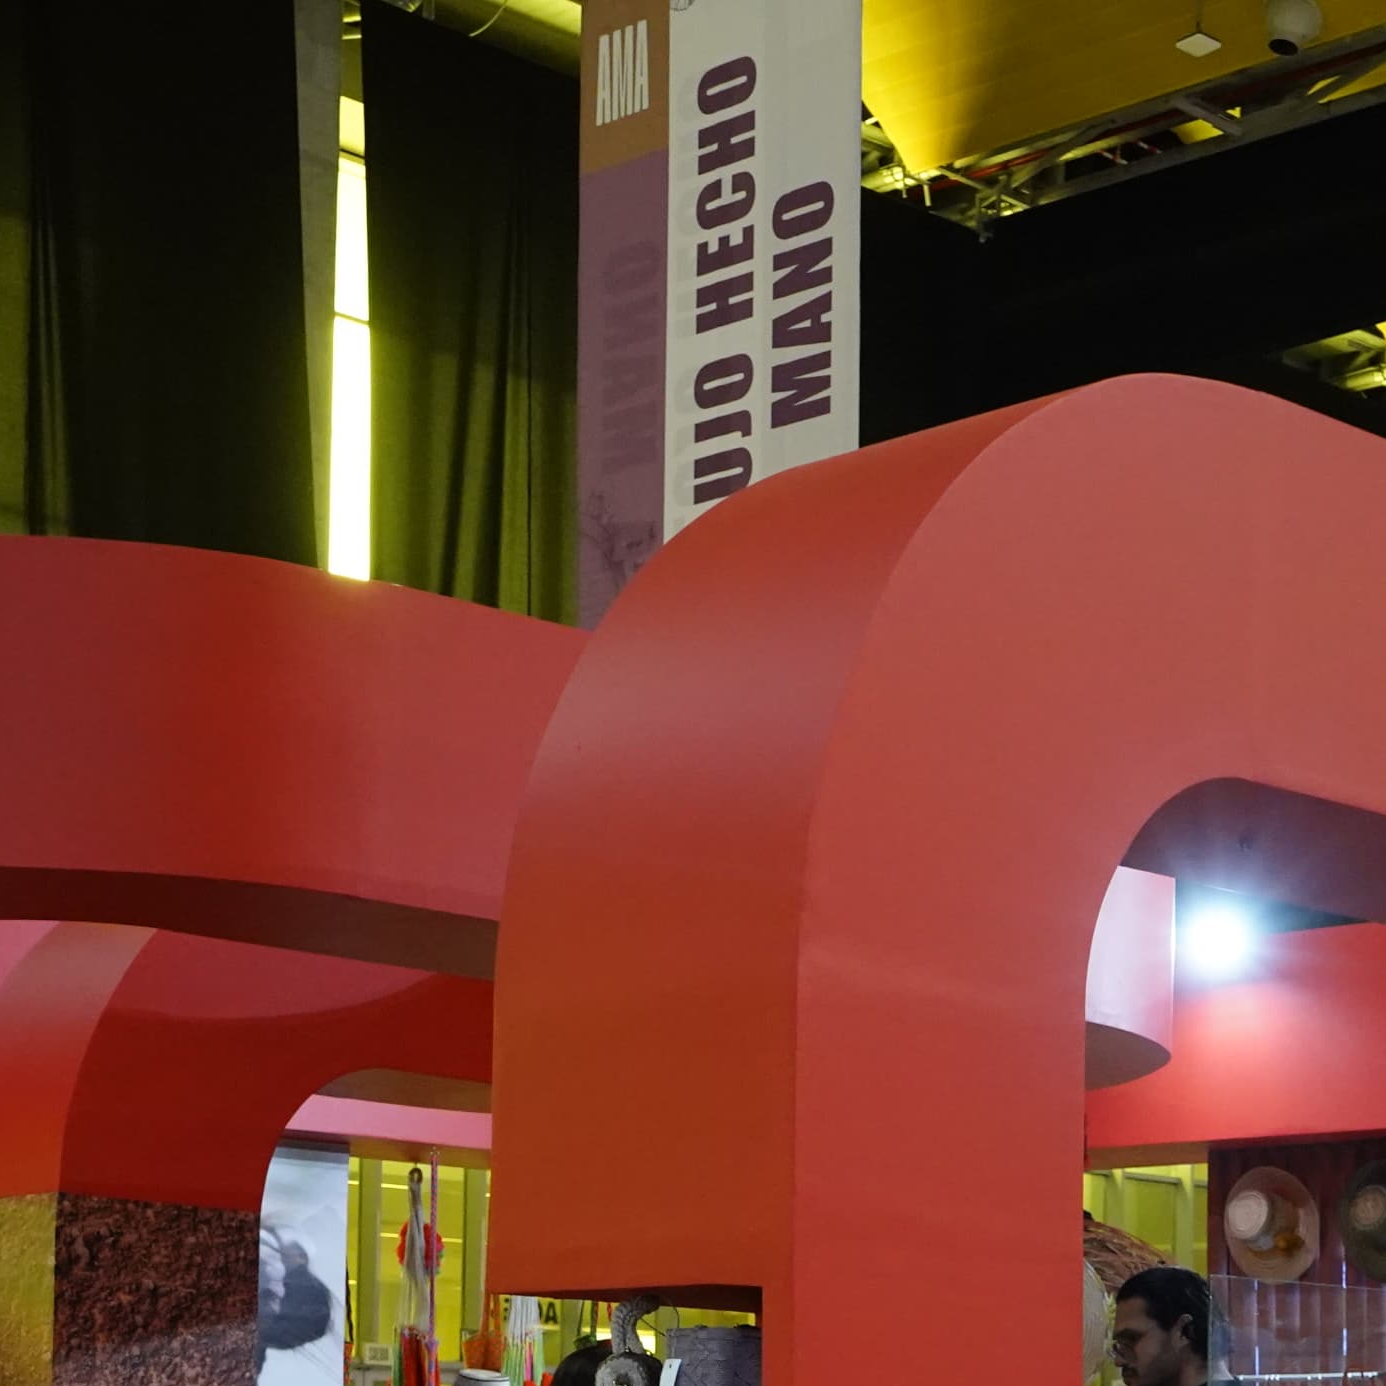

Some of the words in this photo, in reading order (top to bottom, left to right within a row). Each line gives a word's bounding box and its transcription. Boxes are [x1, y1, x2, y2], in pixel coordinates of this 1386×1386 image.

[695, 55, 758, 335] HECHO
[770, 180, 836, 430] MANO
[693, 352, 755, 505] UJO
